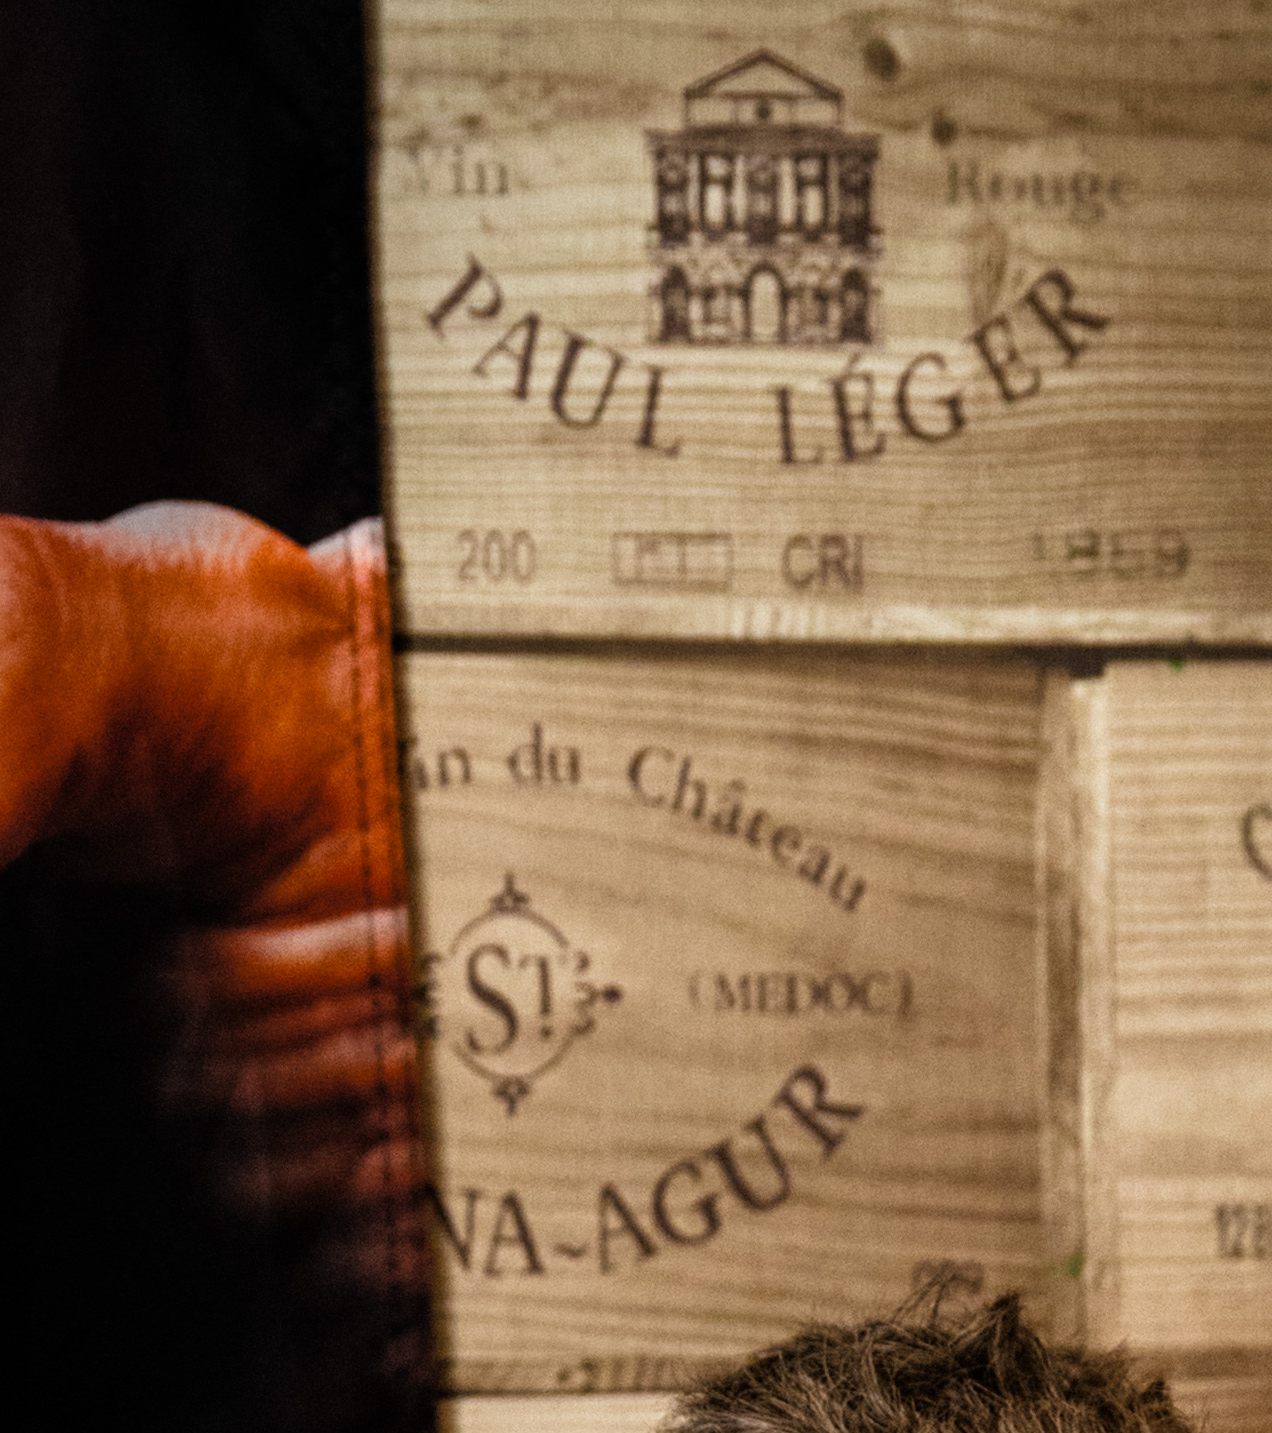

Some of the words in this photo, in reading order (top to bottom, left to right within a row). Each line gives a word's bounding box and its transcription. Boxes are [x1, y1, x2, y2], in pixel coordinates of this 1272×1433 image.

[417, 250, 686, 461] PAUL
[770, 266, 1116, 468] LÉGER
[455, 528, 537, 585] 200
[507, 722, 581, 790] du
[623, 745, 870, 915] Château
